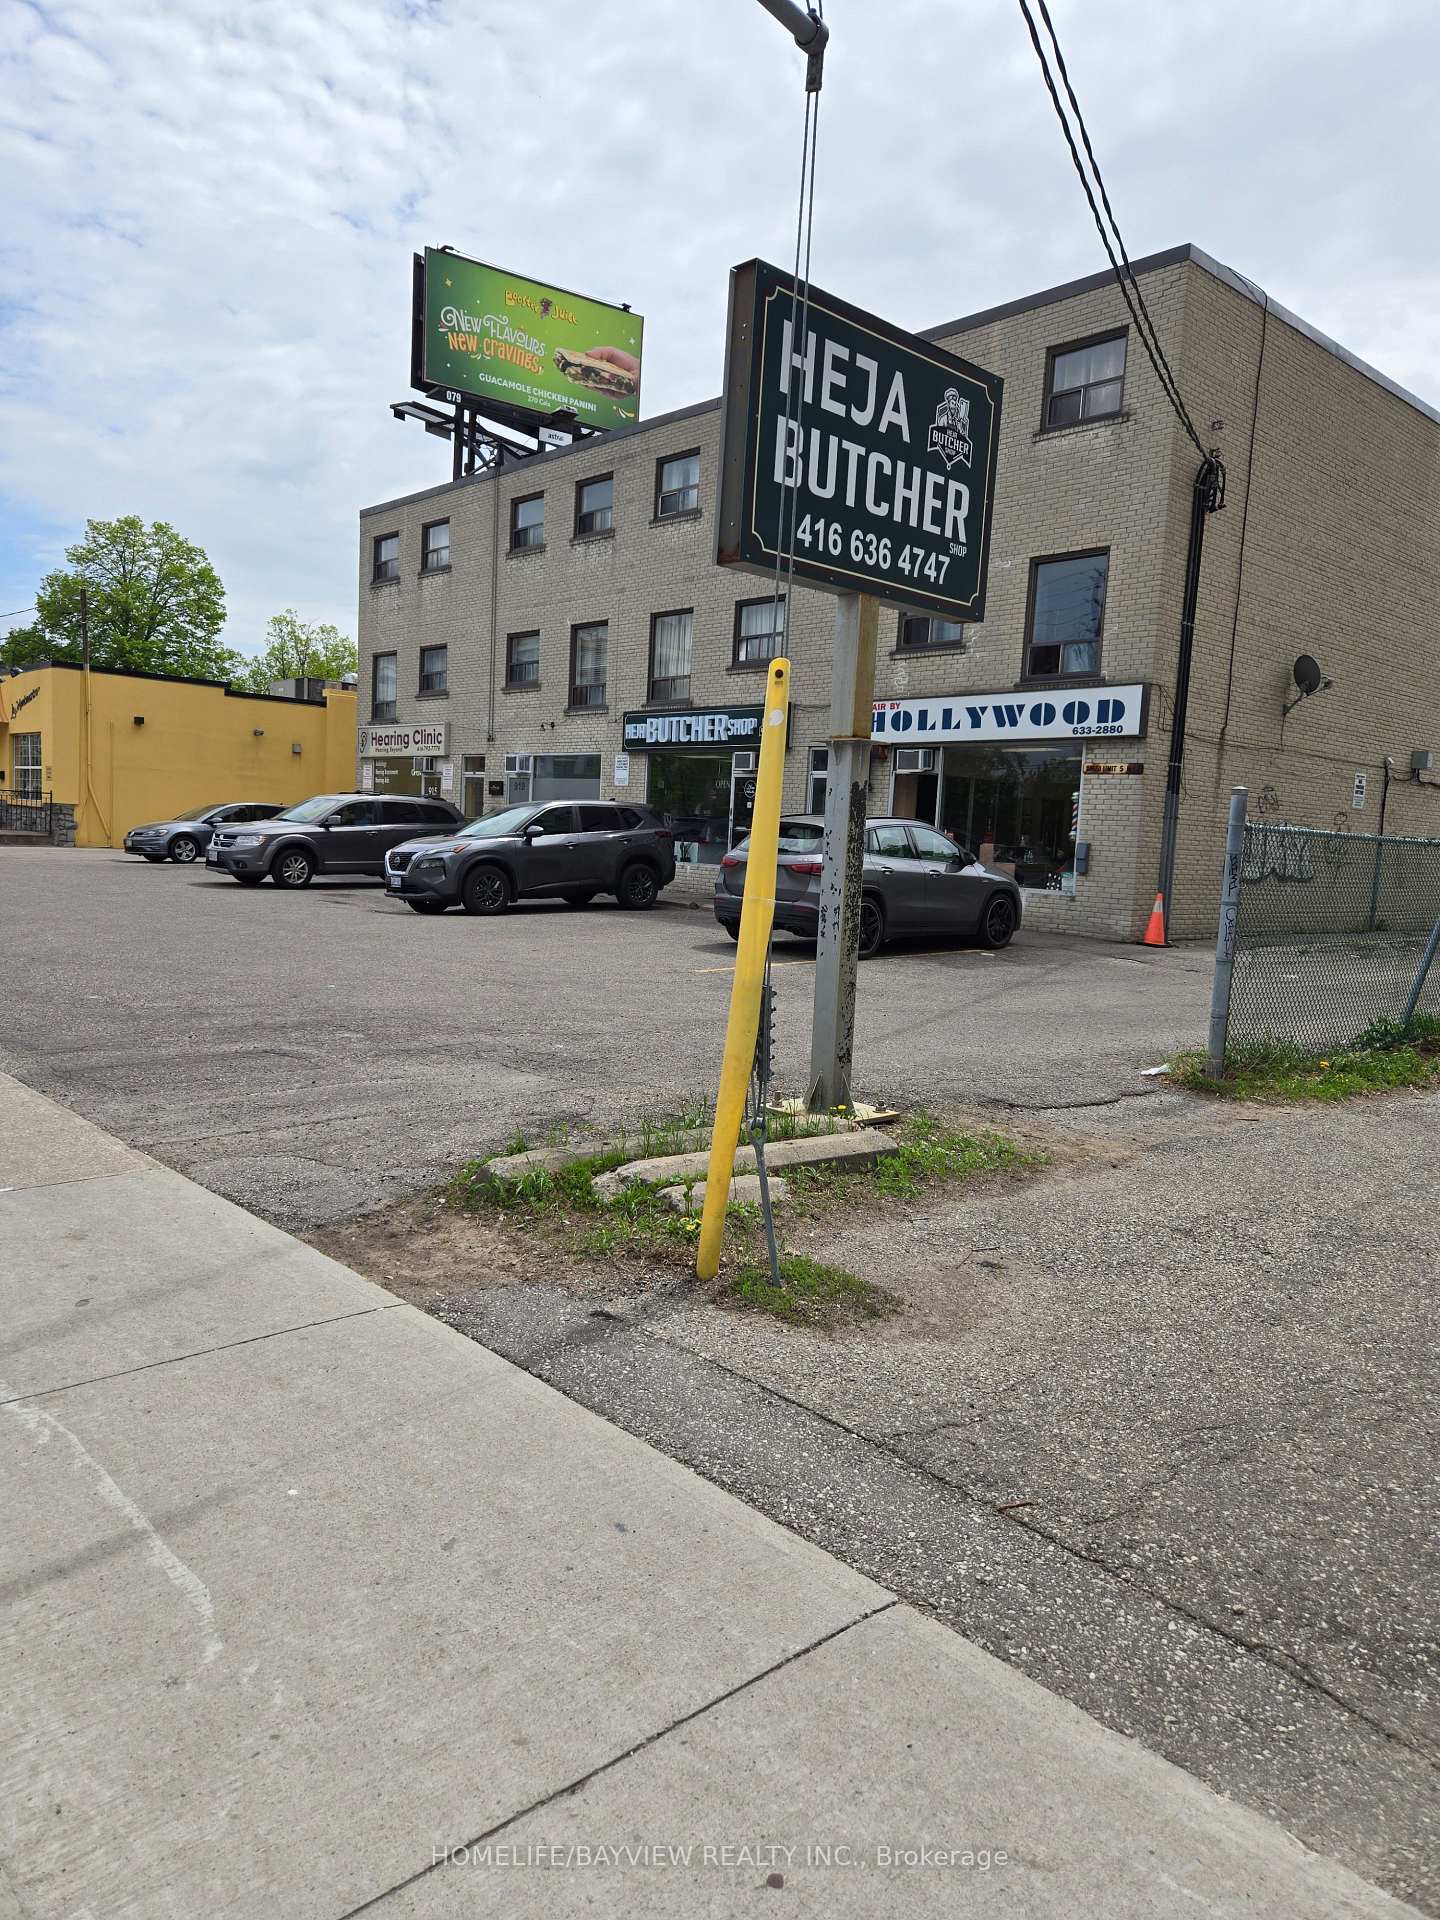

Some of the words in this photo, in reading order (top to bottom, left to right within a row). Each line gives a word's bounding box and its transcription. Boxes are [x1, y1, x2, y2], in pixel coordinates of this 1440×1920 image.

[551, 305, 577, 325] Juice
[483, 314, 545, 357] FLAVOURS
[479, 372, 532, 394] GUACAMOLE
[532, 387, 569, 404] CHICKEN
[568, 398, 597, 412] PANINI
[779, 319, 911, 443] HEJA
[446, 390, 462, 403] 079
[932, 430, 969, 455] BUTCHER
[773, 415, 970, 544] BUTCHER
[796, 513, 843, 556] 416
[850, 529, 892, 570] 636
[898, 544, 950, 585] 4747
[949, 542, 967, 557] SHOP
[871, 698, 1126, 733] HOLLYWOOD
[872, 703, 886, 711] AIR
[890, 702, 901, 710] BY
[371, 730, 410, 749] Hearing
[412, 728, 443, 745] Clinic
[646, 714, 729, 743] BUTCHER
[1072, 725, 1123, 735] 633-2880
